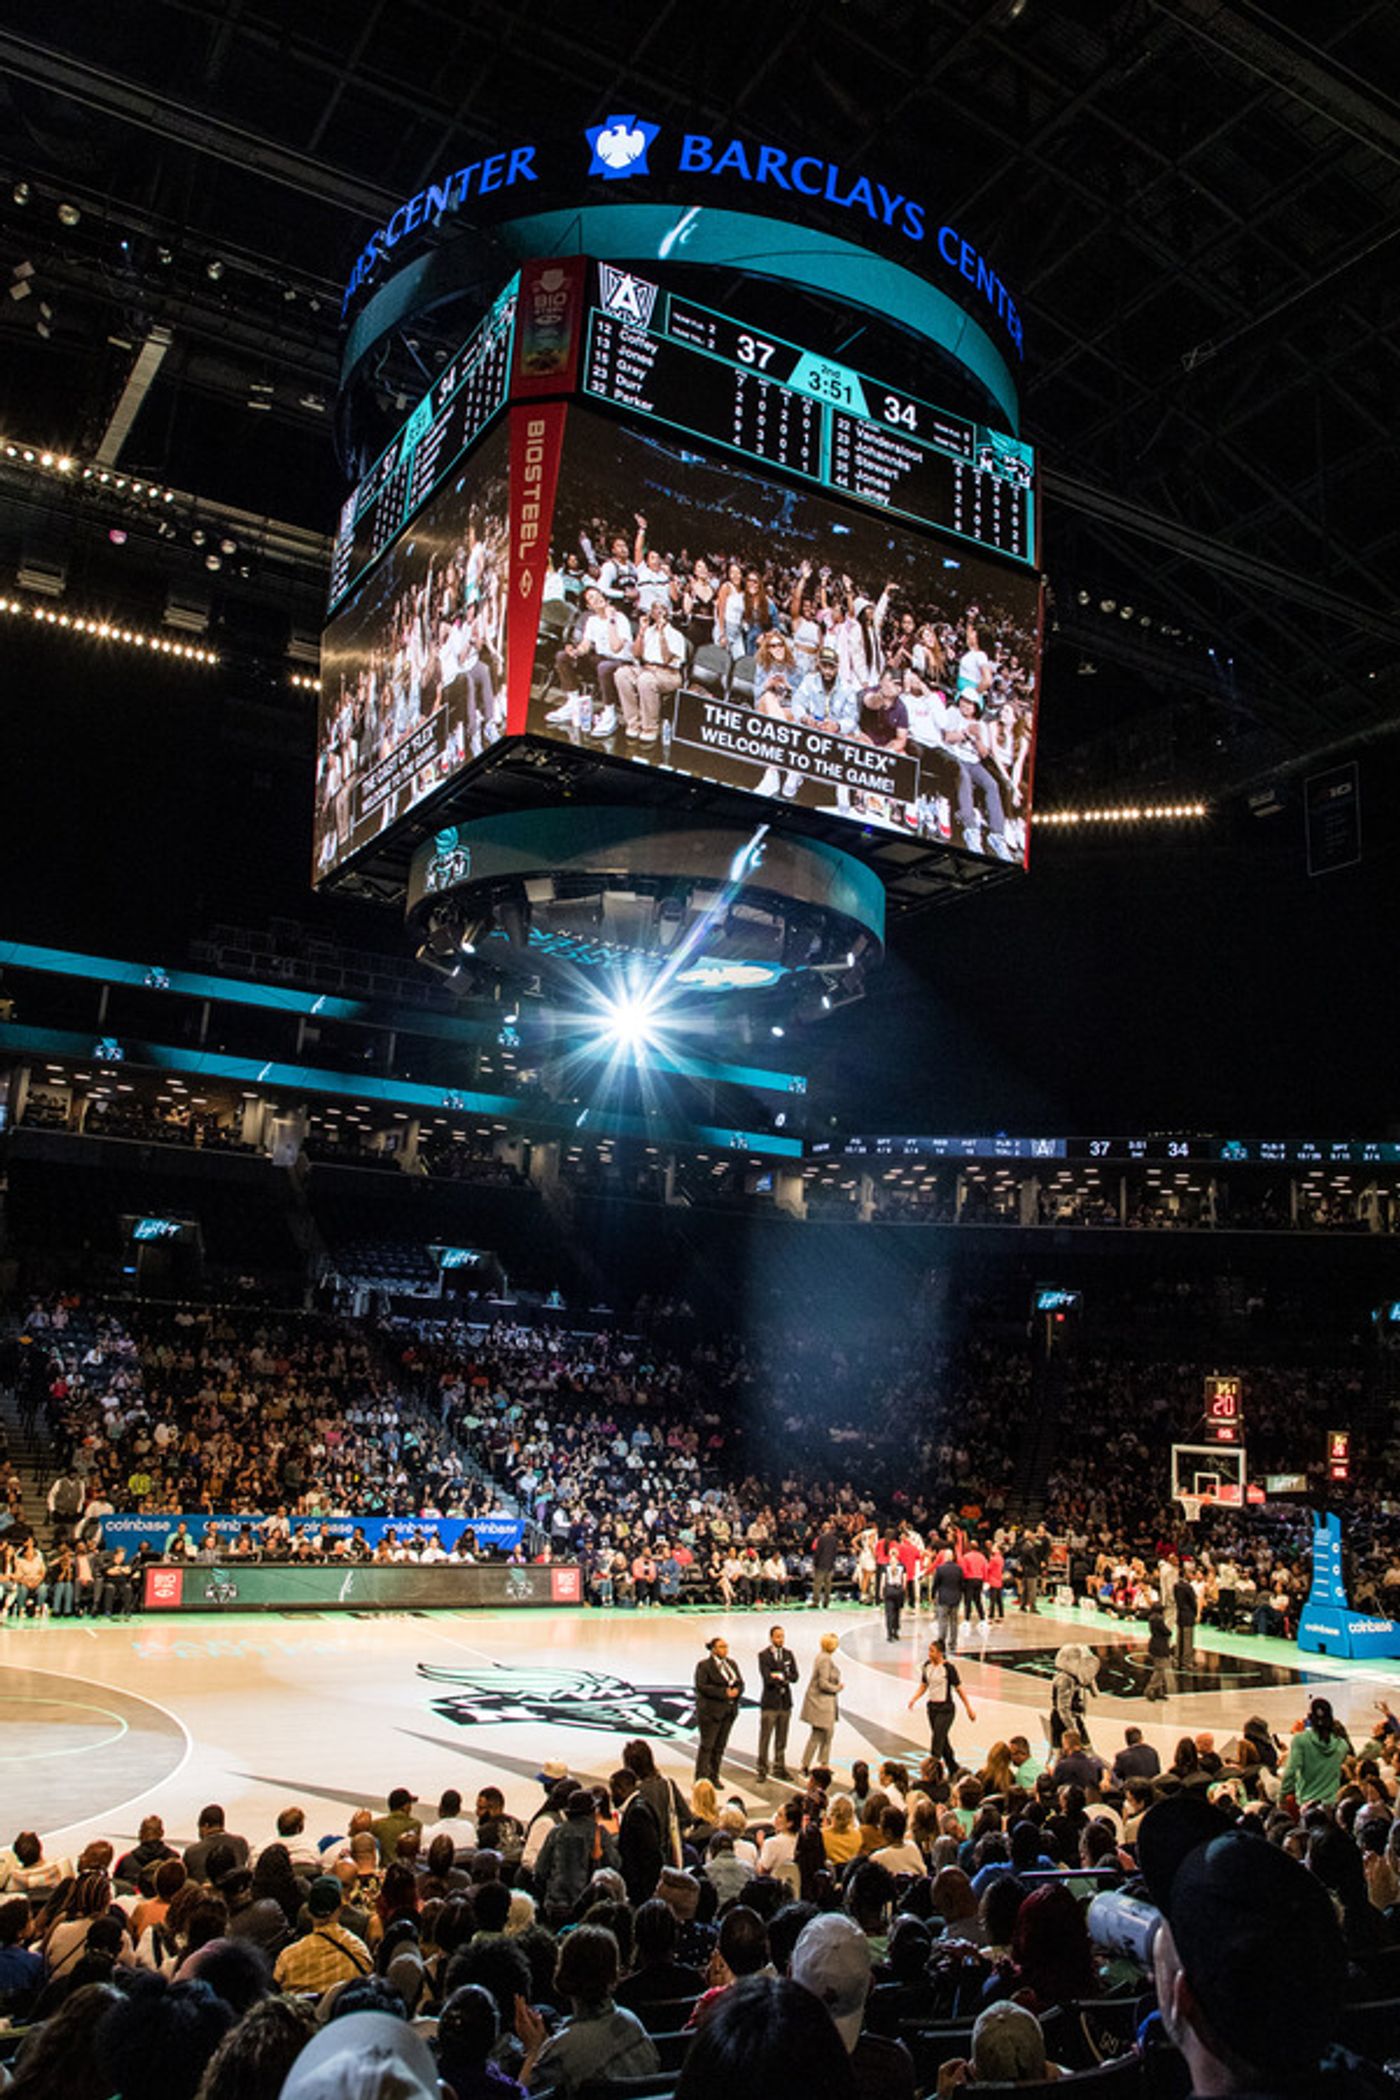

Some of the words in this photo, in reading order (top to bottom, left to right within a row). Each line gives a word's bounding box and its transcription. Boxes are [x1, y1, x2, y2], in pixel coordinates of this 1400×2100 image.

[385, 146, 539, 248] CENTER
[678, 134, 926, 241] BARCLAYS
[937, 226, 1024, 363] CENTER
[597, 321, 613, 335] 12
[618, 329, 659, 354] Coffey
[736, 333, 776, 370] 37
[596, 335, 611, 350] 13
[617, 345, 654, 368] Jones
[758, 400, 767, 412] 0
[802, 418, 811, 430] 0
[614, 388, 655, 413] Parker
[616, 359, 647, 381] Gray
[780, 423, 788, 435] 0
[808, 371, 852, 405] 3:51
[615, 373, 644, 392] Durr
[779, 438, 788, 449] 0
[801, 446, 810, 458] 0
[884, 396, 918, 431] 34
[518, 420, 545, 559] BIOSTEEL
[704, 704, 743, 732] THE
[747, 714, 801, 746] CAST
[806, 735, 832, 756] OF
[701, 726, 786, 763] WELCOME
[788, 750, 811, 770] TO
[814, 758, 842, 779] THE
[846, 769, 896, 793] GAME!
[1089, 1141, 1111, 1157] 37
[1168, 1141, 1190, 1157] 34
[1212, 1394, 1235, 1417] 20
[104, 1517, 172, 1533] coinbase
[1348, 1618, 1394, 1634] coinbase
